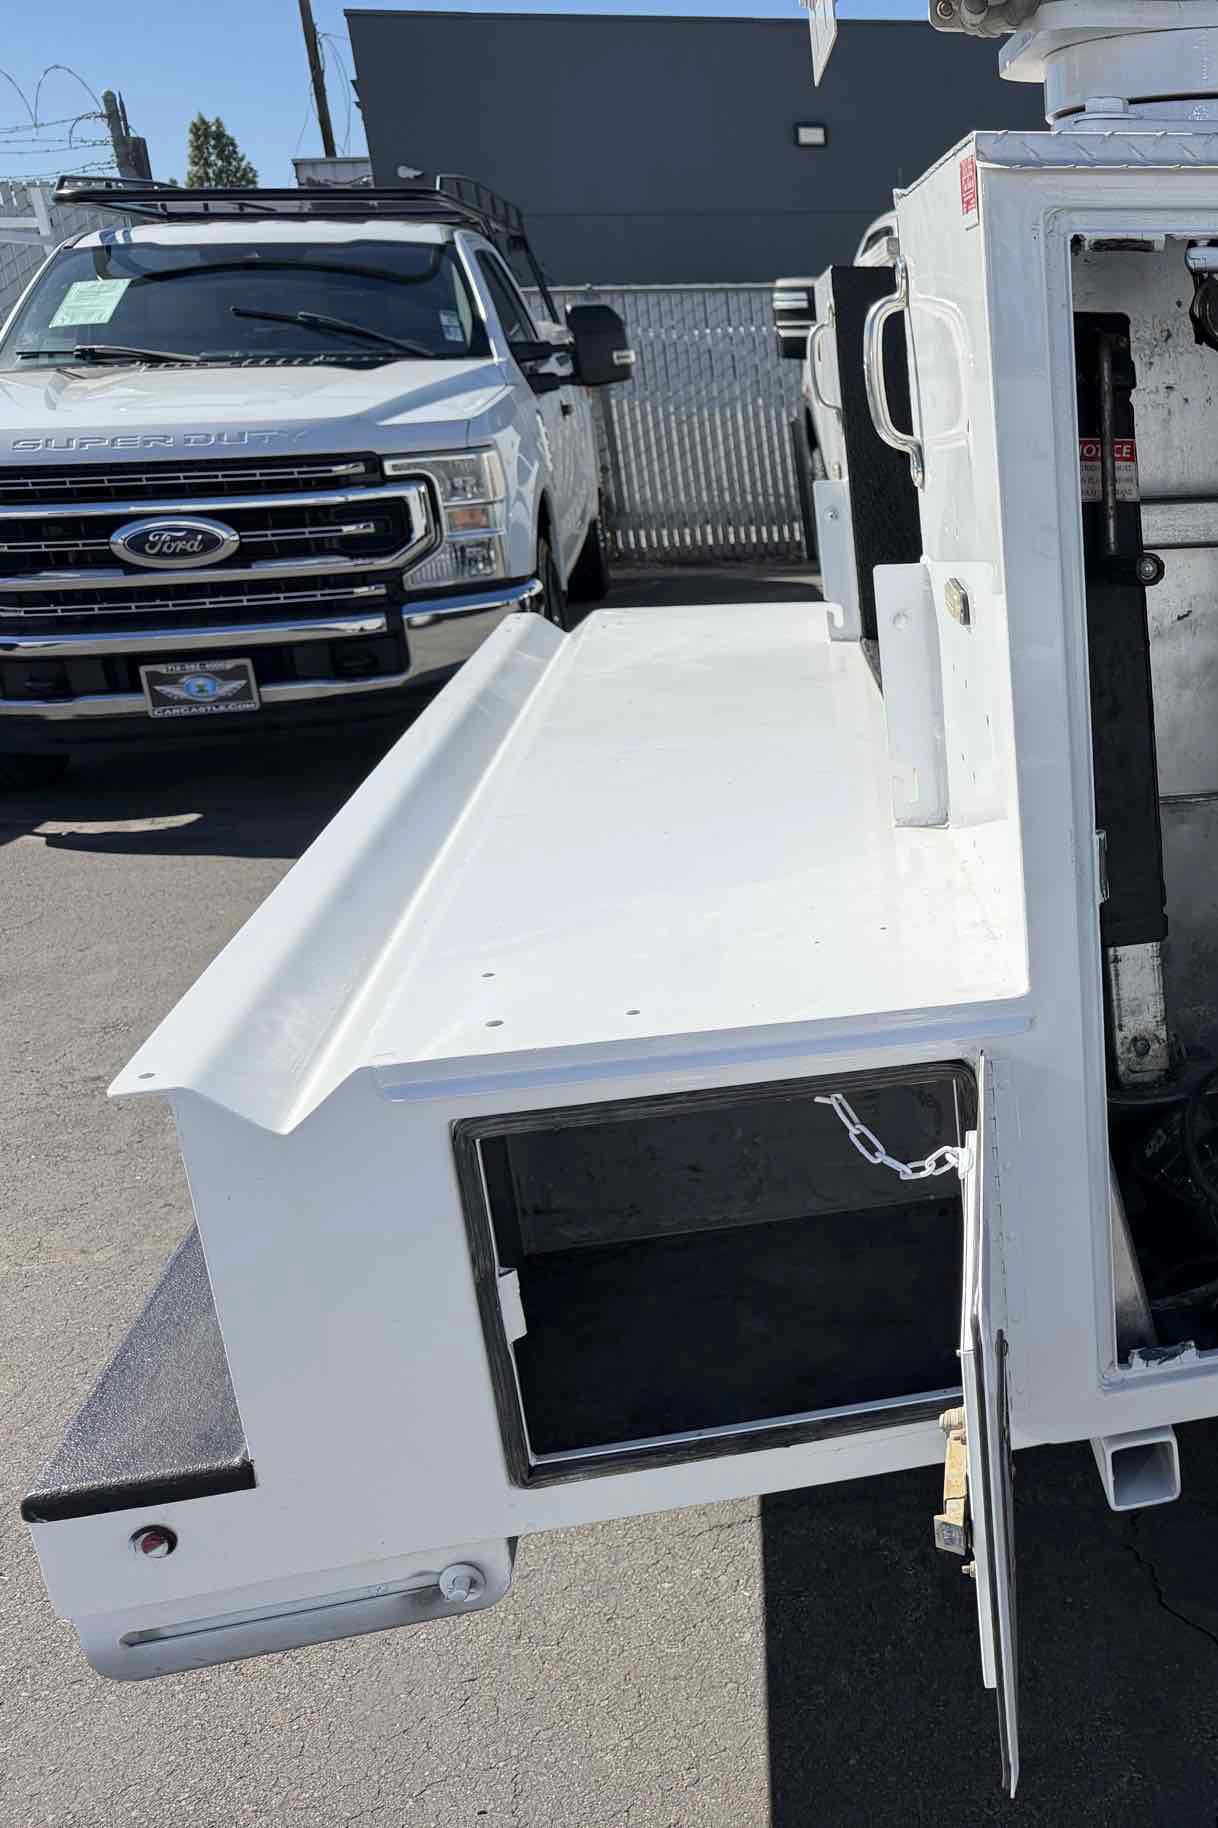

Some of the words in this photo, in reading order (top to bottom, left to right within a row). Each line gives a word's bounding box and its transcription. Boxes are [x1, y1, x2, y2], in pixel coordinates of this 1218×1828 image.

[11, 434, 176, 453] SUPER
[183, 430, 306, 448] DUTY
[1080, 444, 1132, 458] OTCE
[144, 530, 203, 555] Ford
